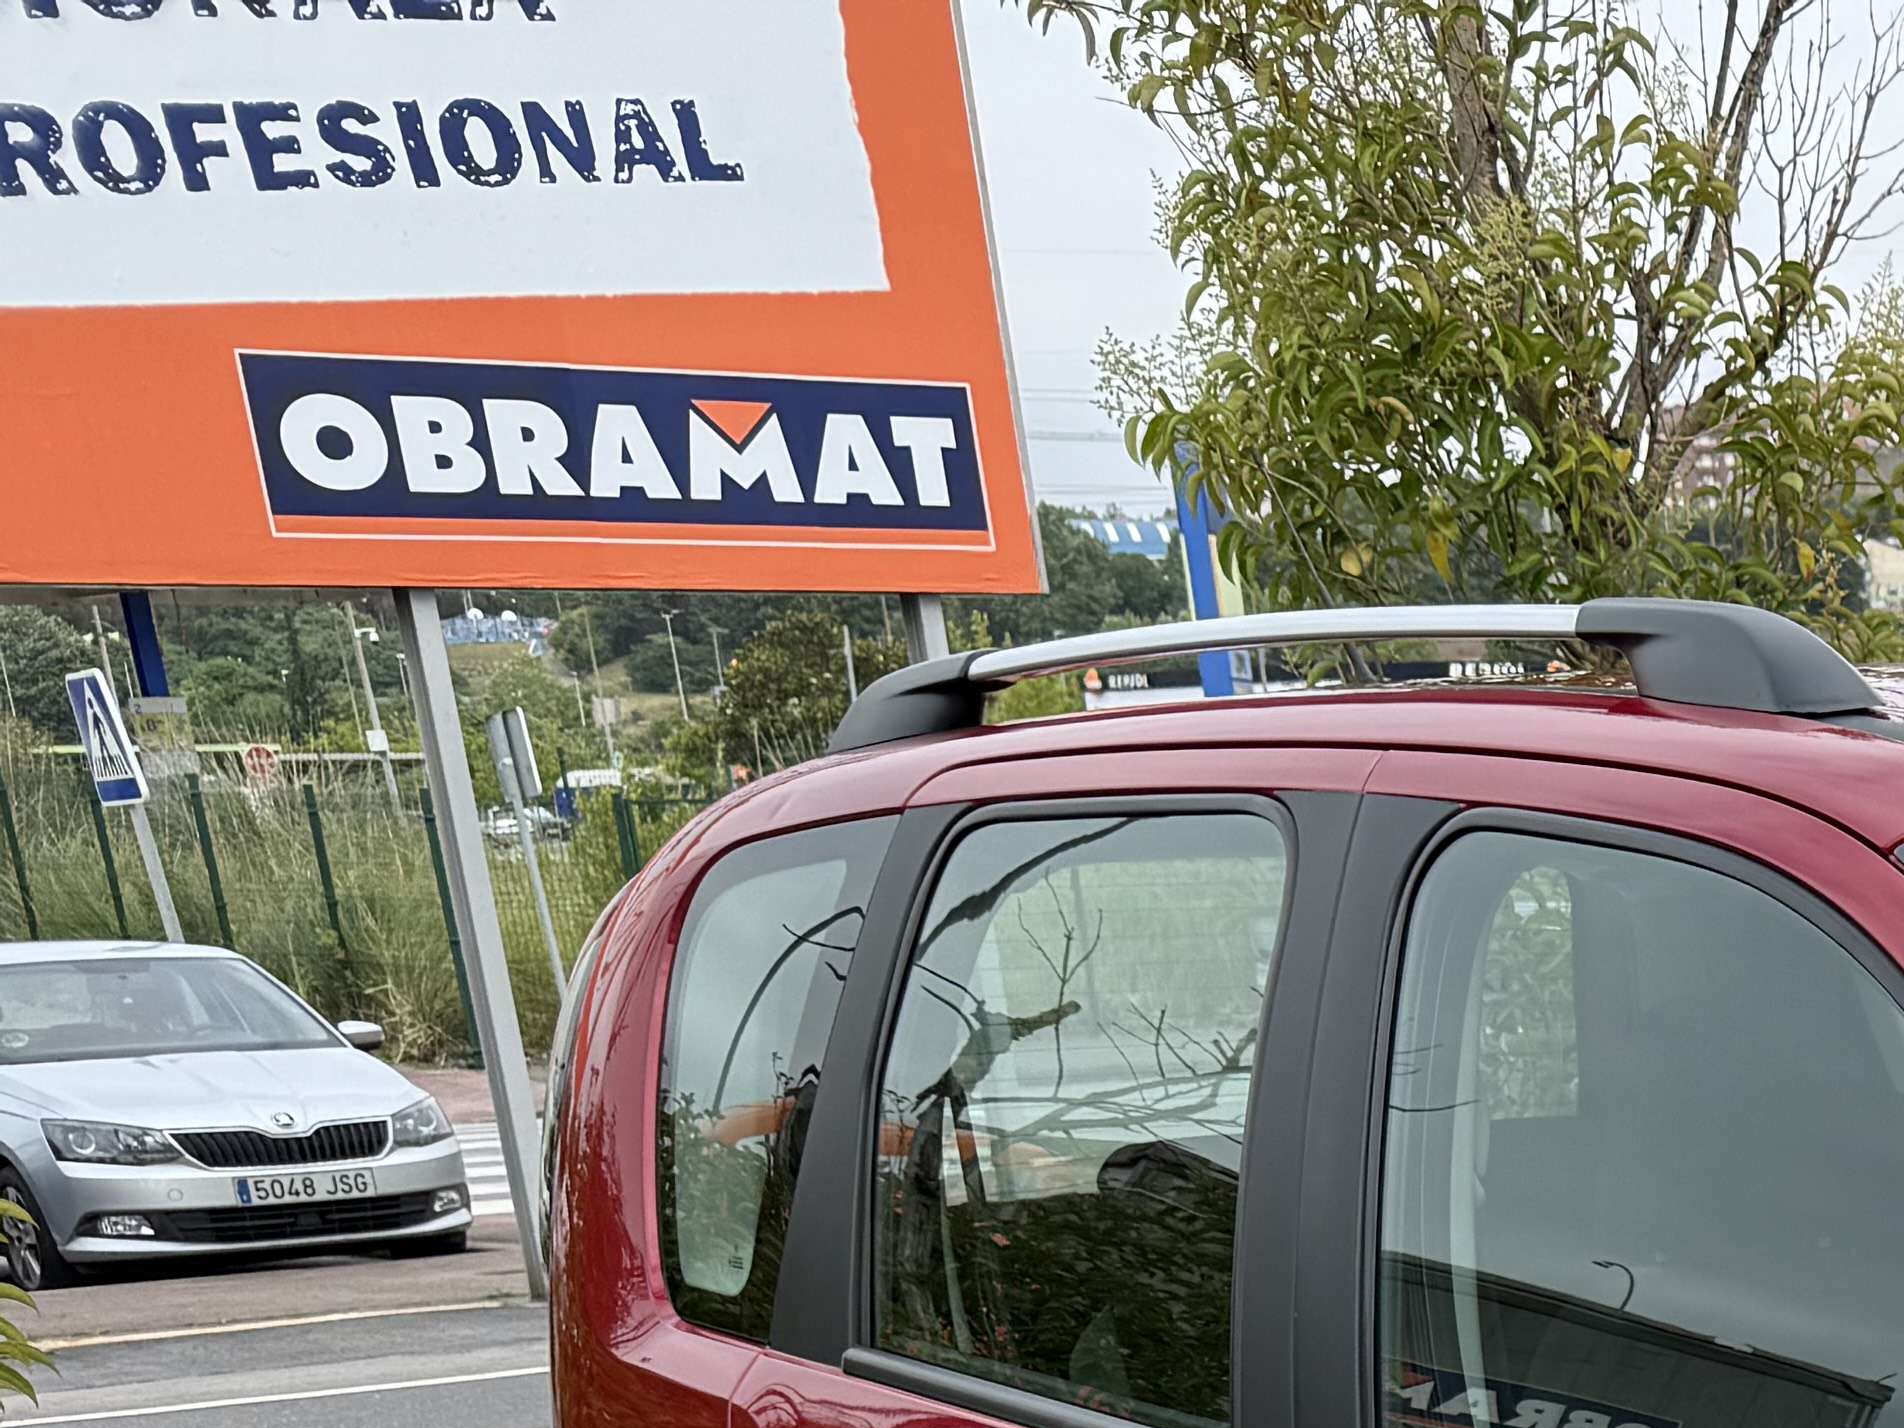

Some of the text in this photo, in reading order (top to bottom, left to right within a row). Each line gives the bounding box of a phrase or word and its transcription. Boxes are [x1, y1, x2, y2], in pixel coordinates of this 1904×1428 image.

[279, 393, 957, 507] OBRAMAT
[254, 1173, 368, 1200] 5048 JSG
